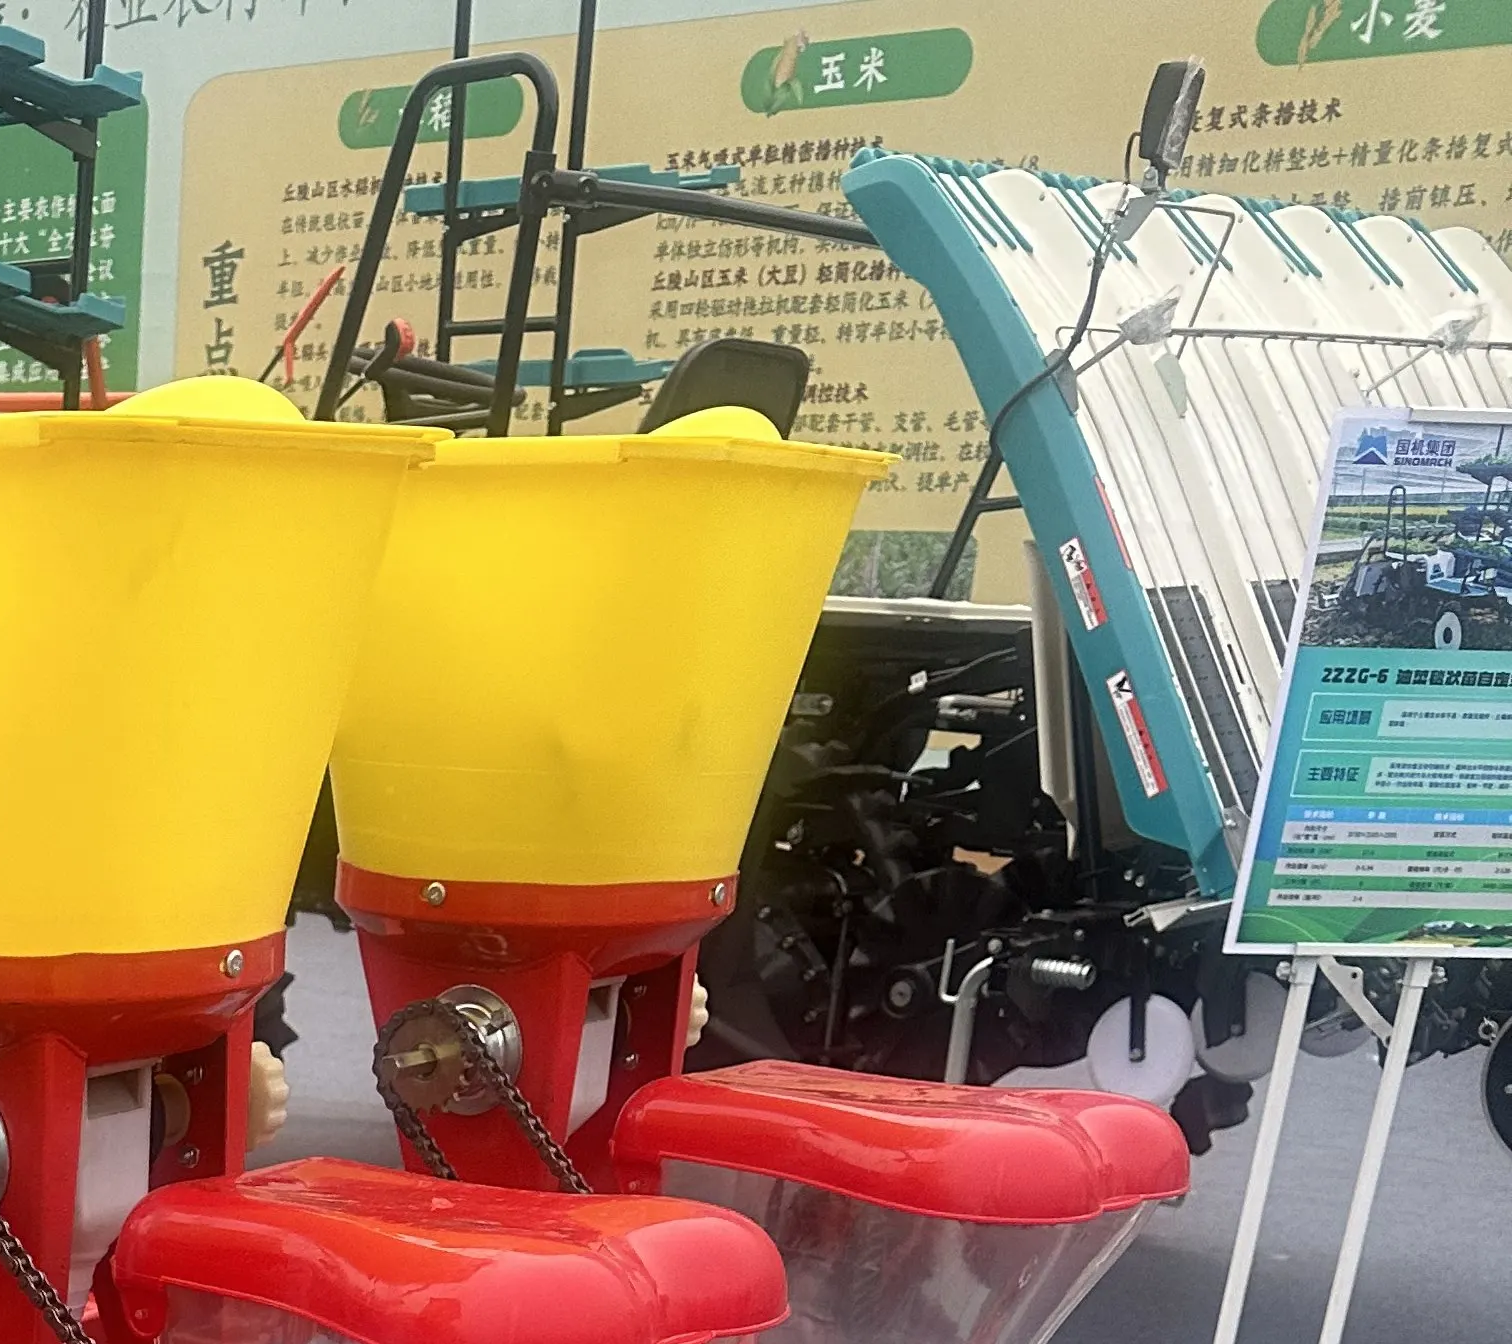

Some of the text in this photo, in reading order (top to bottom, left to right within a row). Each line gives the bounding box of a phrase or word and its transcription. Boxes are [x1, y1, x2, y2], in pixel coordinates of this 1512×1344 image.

[1350, 0, 1445, 45] 小麦
[814, 47, 887, 94] 玉米
[399, 94, 452, 131] 稻
[1395, 438, 1456, 458] 国机集团
[1393, 457, 1453, 467] SINOMACH
[1321, 667, 1389, 684] 2ZZG-6
[1319, 709, 1373, 725] 应用场景
